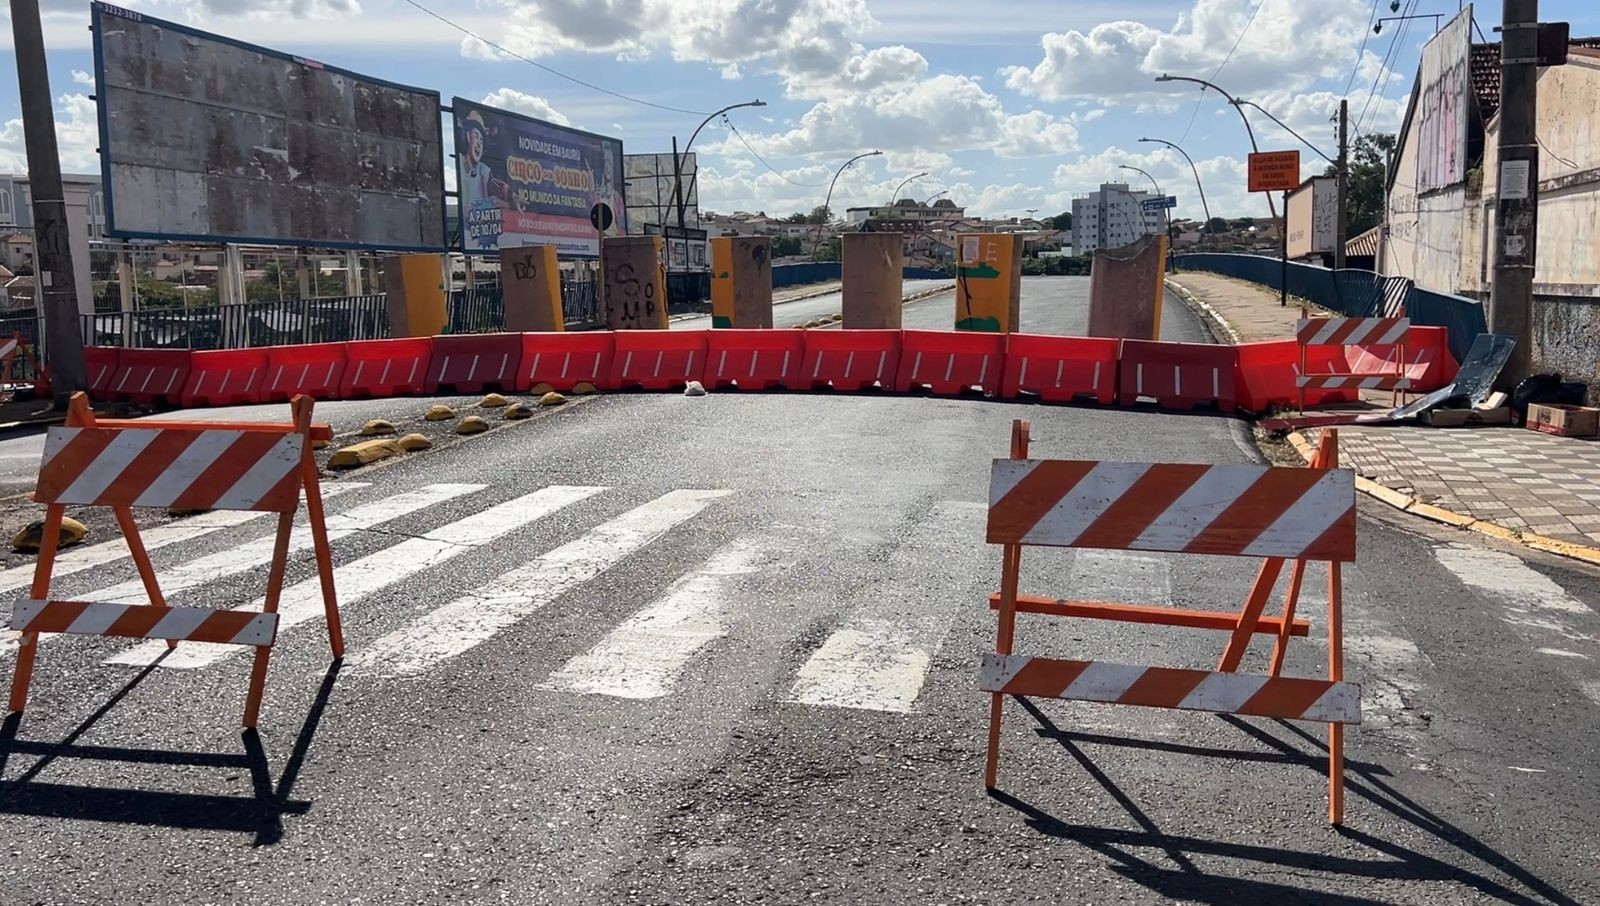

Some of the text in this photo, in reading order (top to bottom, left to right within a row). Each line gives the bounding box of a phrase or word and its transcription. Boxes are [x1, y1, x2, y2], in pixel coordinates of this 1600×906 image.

[518, 136, 581, 161] NOVIDADE EM BAURU
[508, 157, 542, 183] CIRCO
[518, 189, 587, 209] NO MUNDO DA FANTASIA
[469, 208, 502, 223] A PARTIR
[470, 223, 502, 237] DE 10/04
